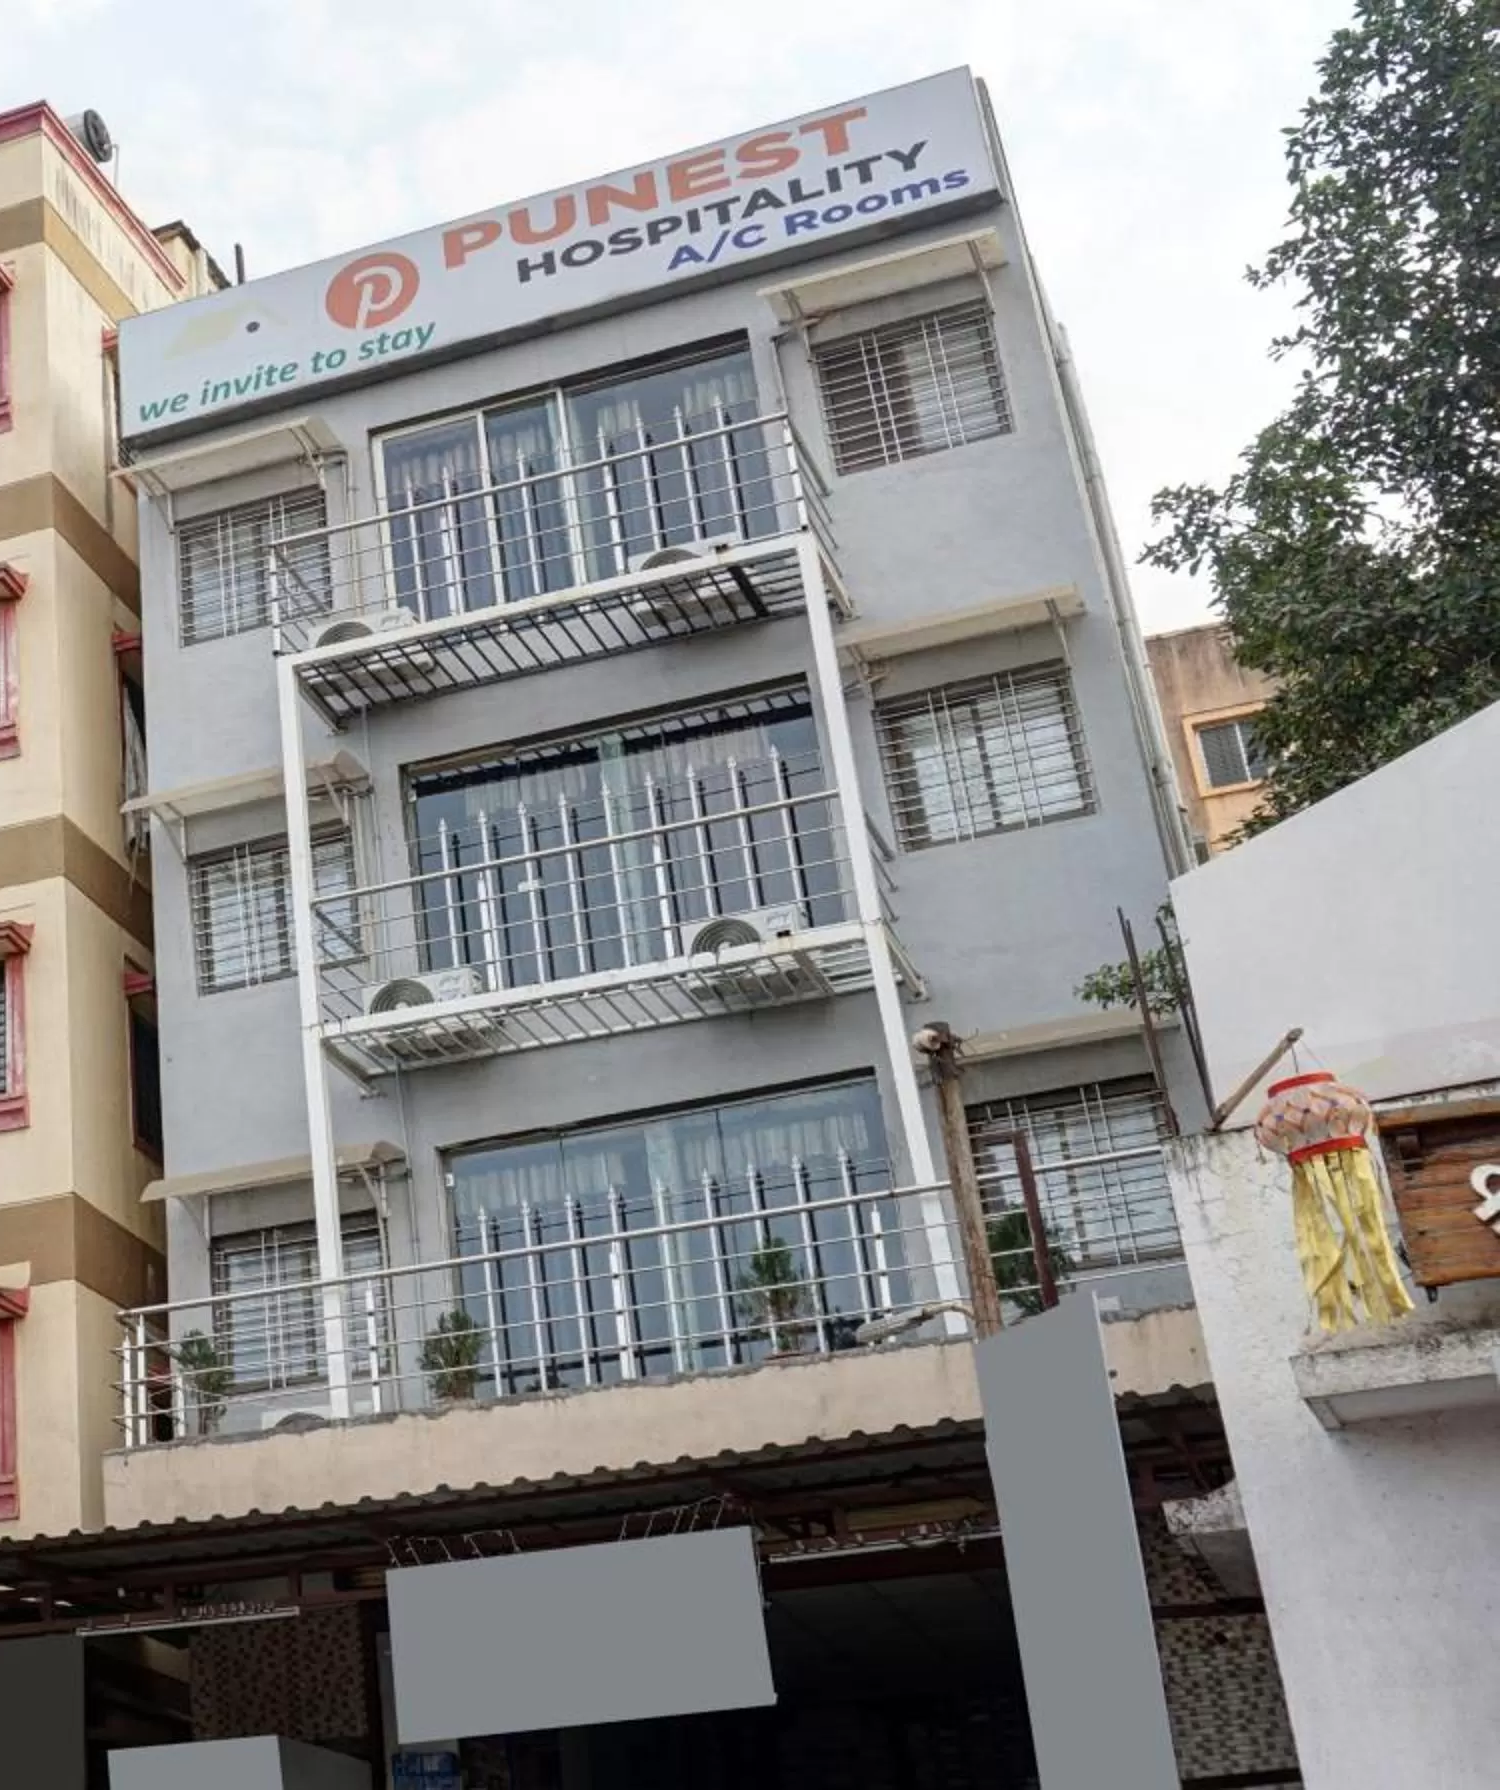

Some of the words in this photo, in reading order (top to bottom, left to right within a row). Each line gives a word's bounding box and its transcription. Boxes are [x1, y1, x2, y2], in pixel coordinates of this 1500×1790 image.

[442, 106, 868, 269] PUNEST
[516, 140, 929, 283] HOSPITALITY
[667, 223, 768, 271] A/C
[783, 168, 971, 237] Rooms
[139, 391, 190, 423] we
[200, 361, 299, 406] invite
[311, 346, 348, 375] to
[356, 321, 436, 362] stay
